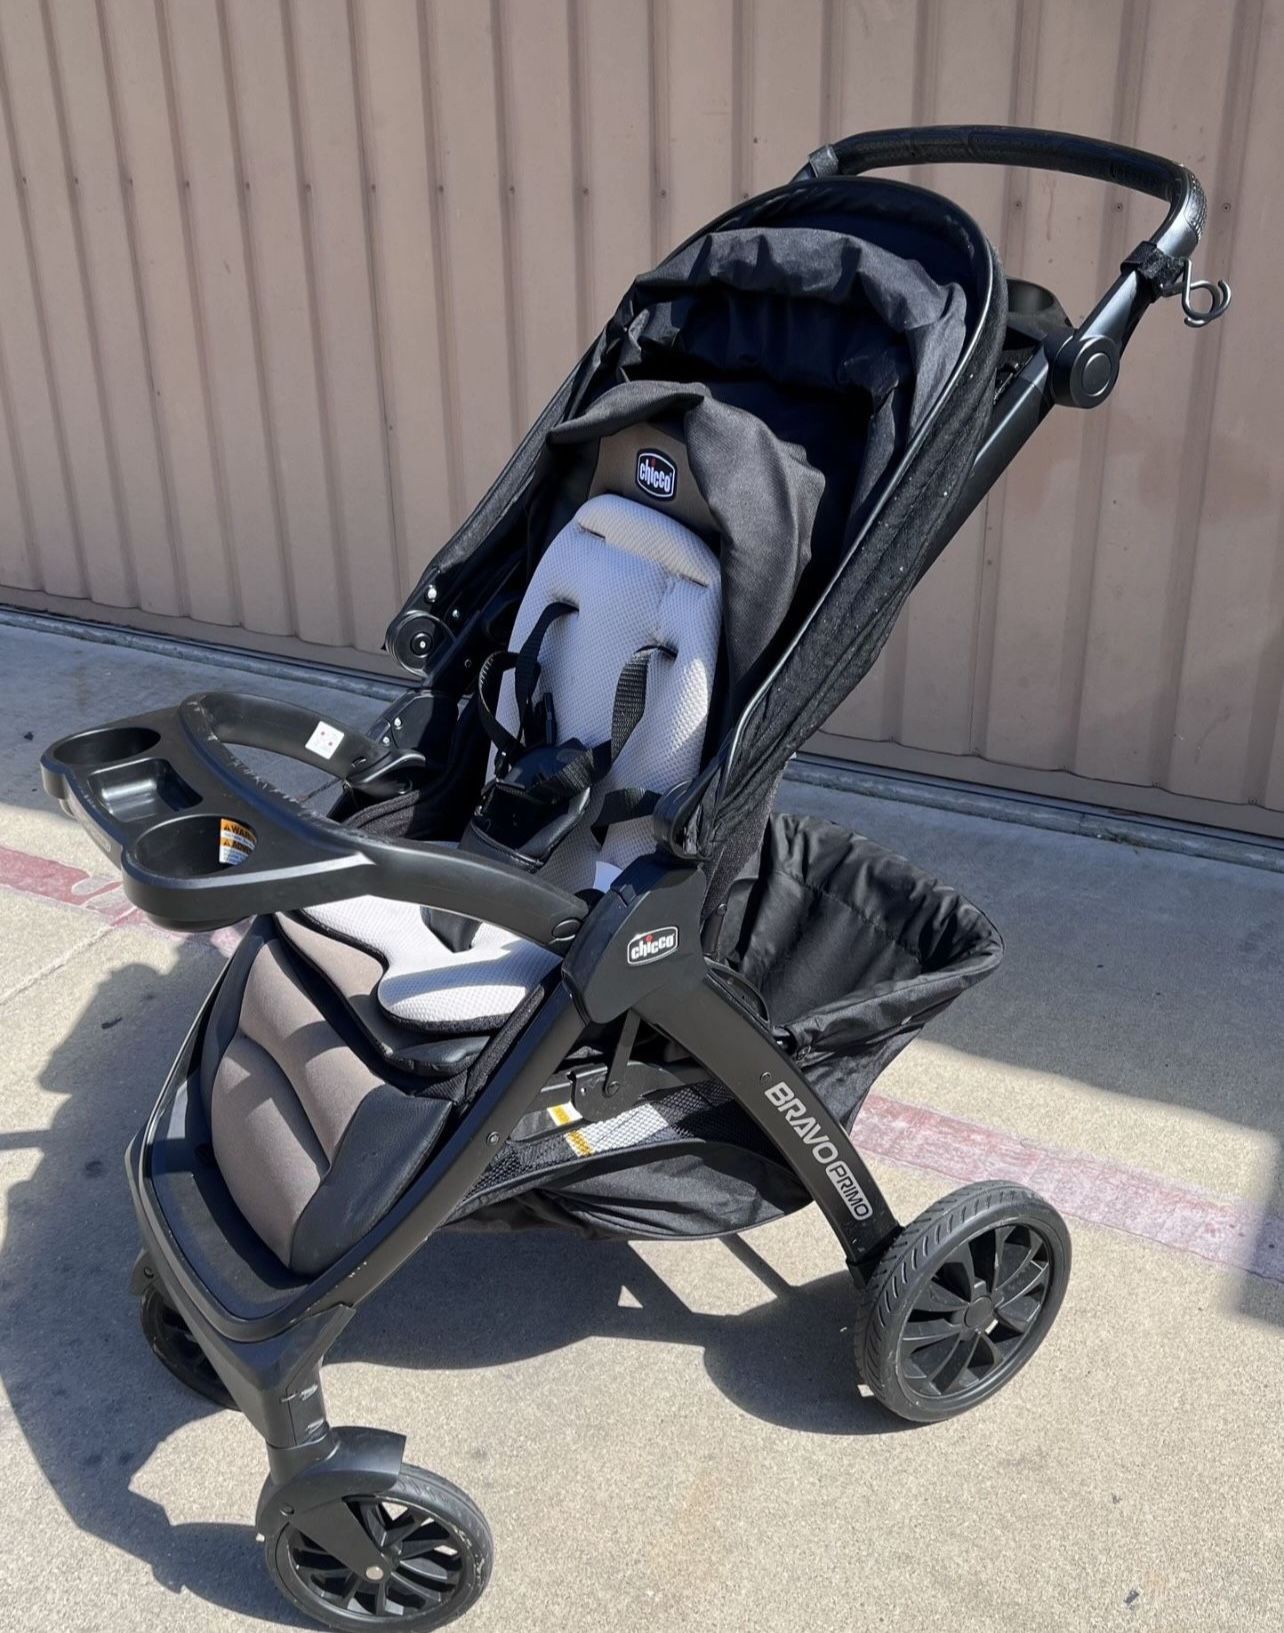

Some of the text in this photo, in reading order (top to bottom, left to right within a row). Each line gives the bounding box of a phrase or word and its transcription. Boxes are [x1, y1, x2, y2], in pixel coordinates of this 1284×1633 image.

[639, 457, 671, 493] chicco
[630, 934, 675, 960] chicco
[764, 1081, 870, 1218] BRAVO PRIMO
